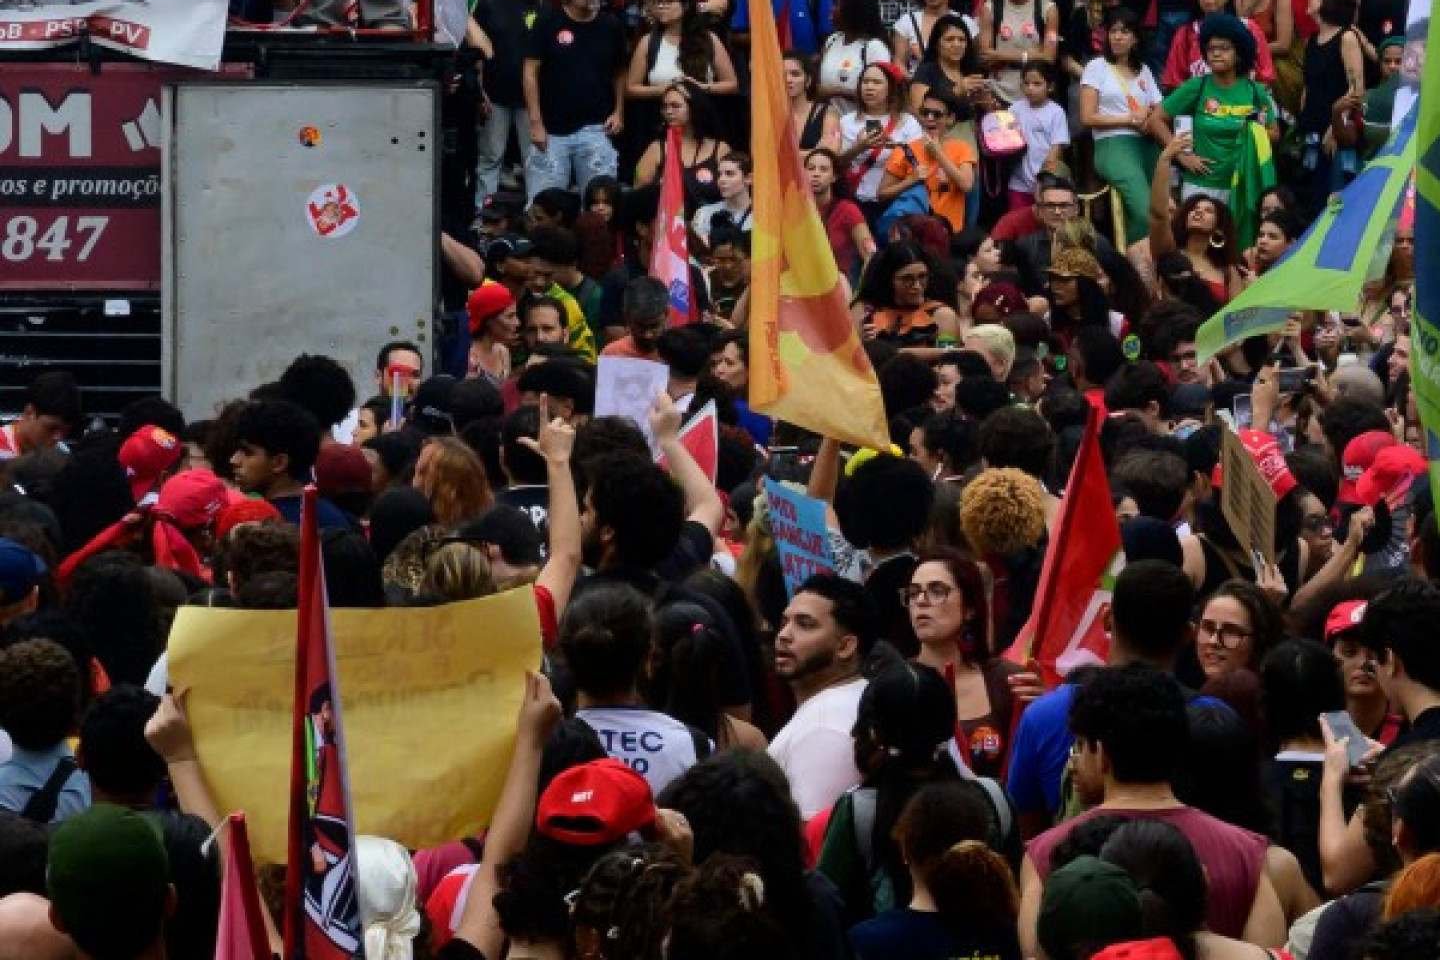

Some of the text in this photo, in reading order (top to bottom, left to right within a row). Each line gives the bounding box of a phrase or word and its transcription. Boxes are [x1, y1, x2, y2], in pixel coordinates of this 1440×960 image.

[0, 93, 92, 157] M
[33, 179, 47, 196] e
[2, 215, 109, 262] 847
